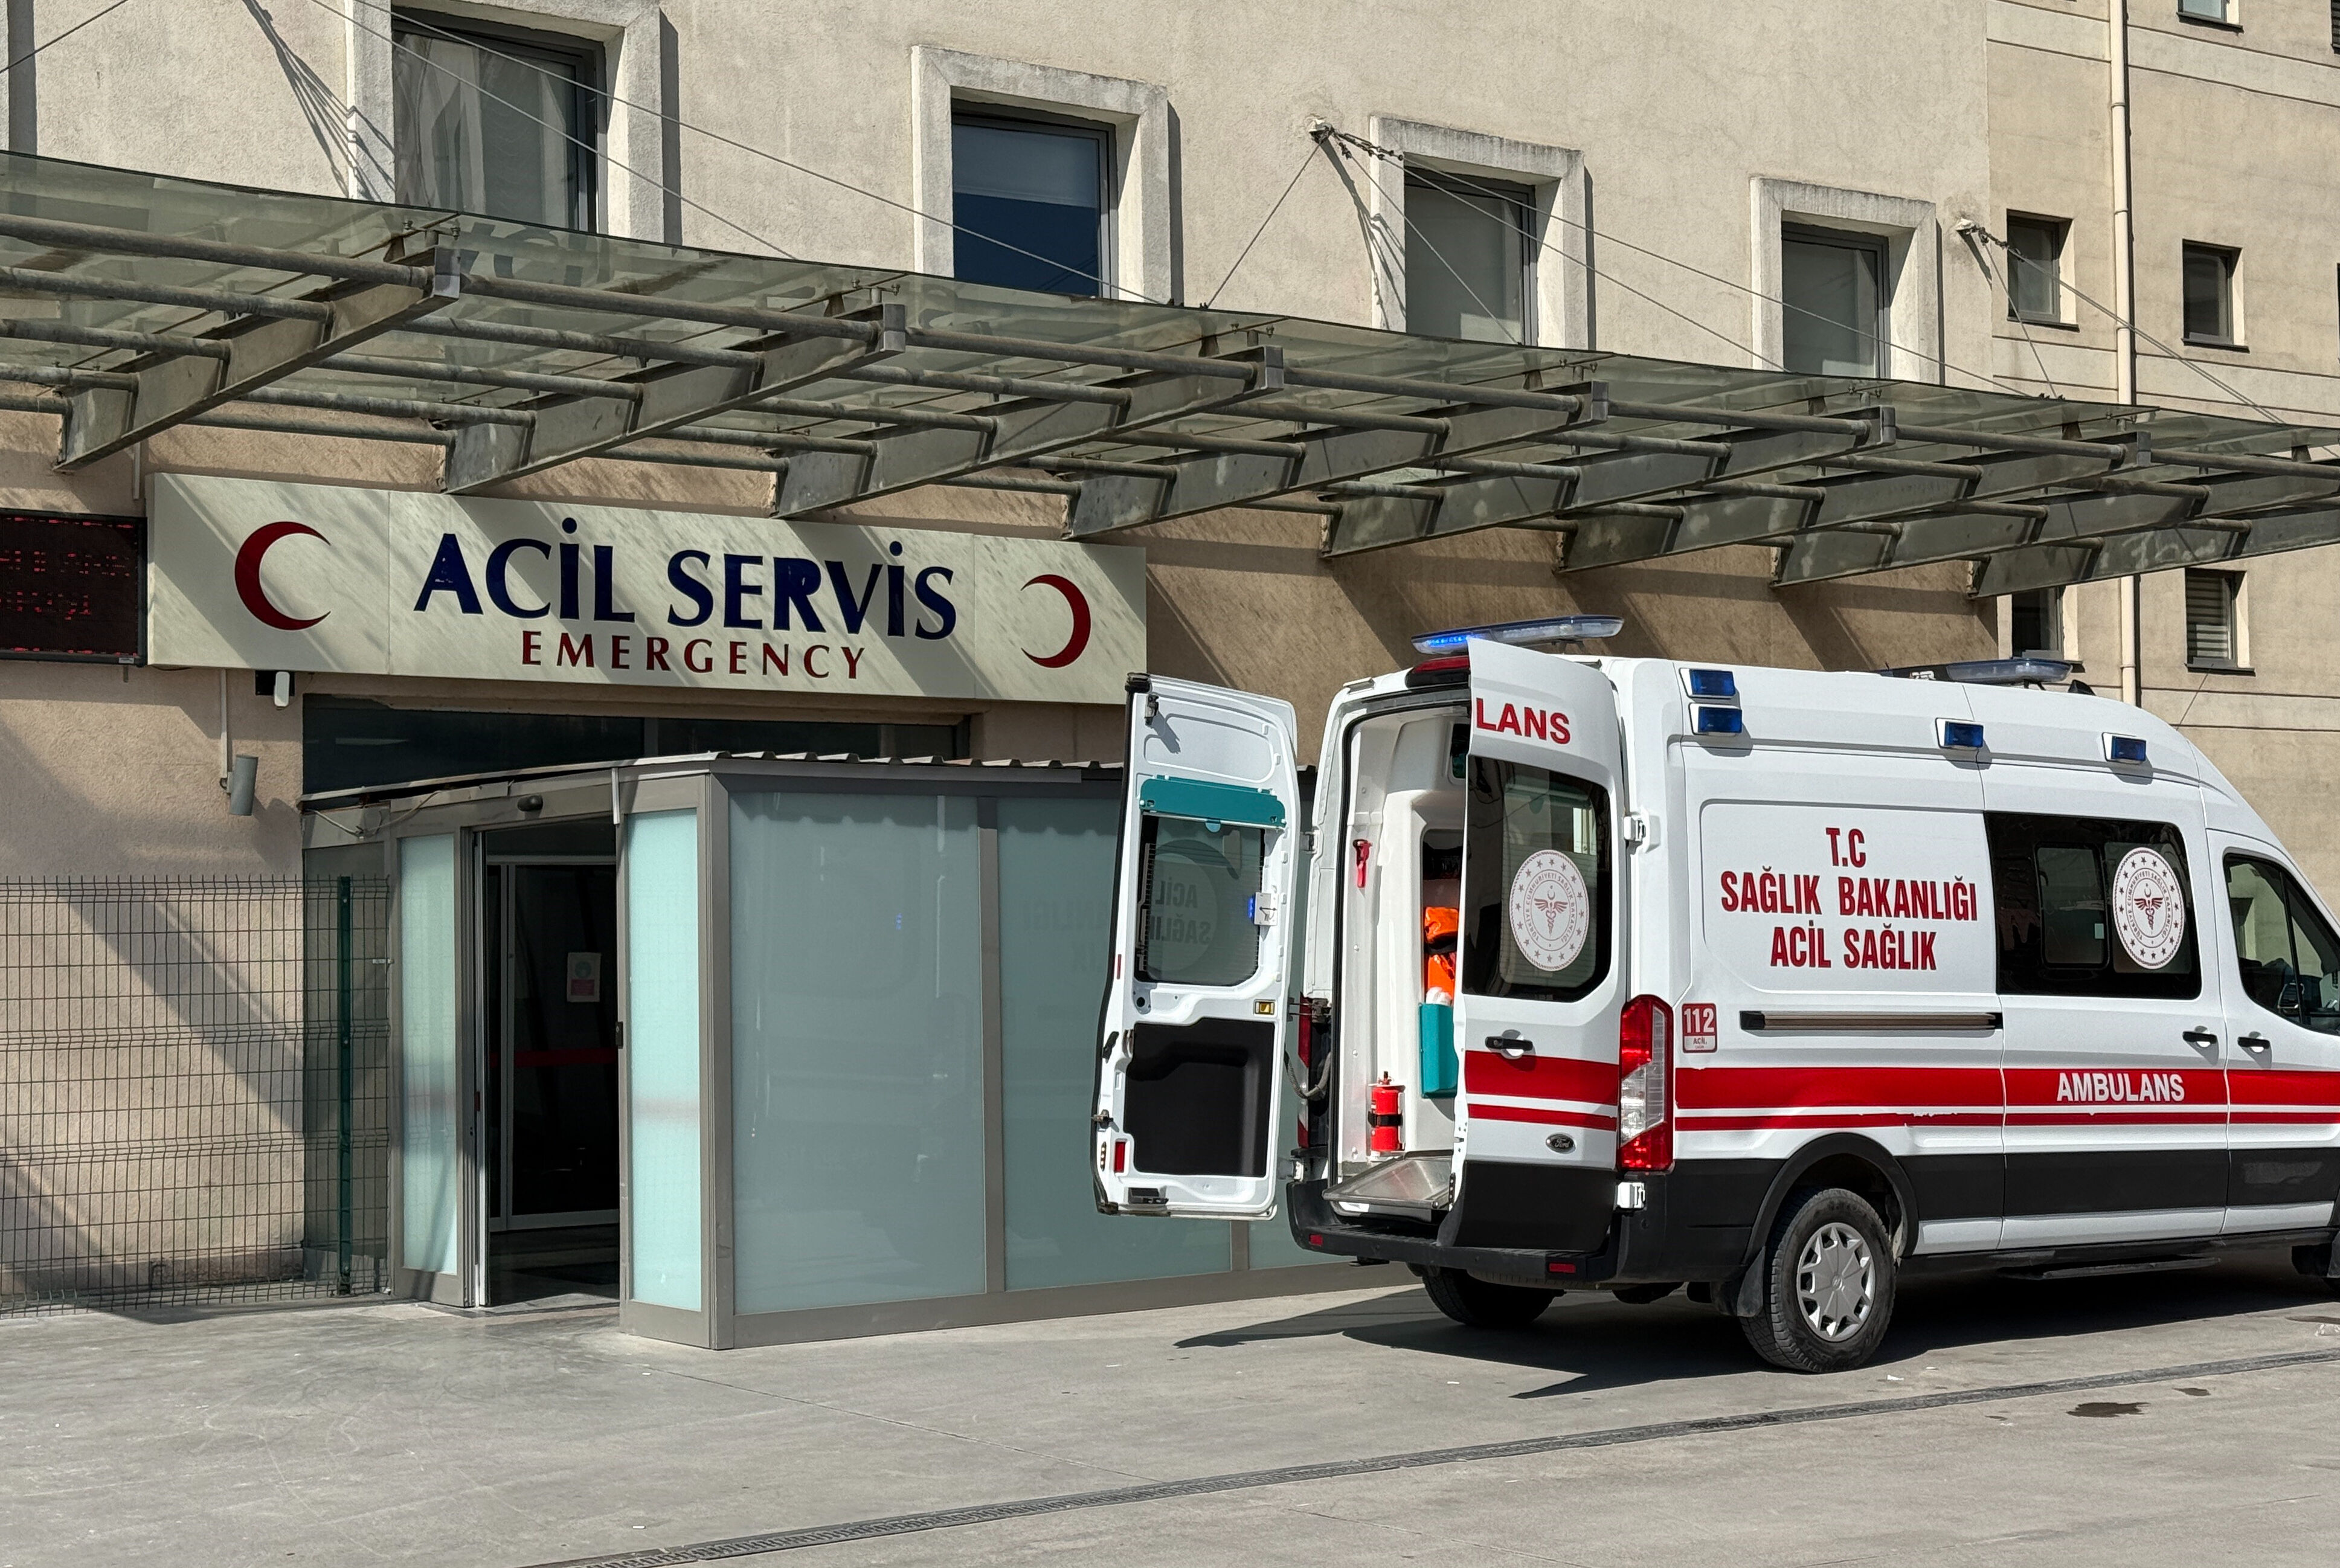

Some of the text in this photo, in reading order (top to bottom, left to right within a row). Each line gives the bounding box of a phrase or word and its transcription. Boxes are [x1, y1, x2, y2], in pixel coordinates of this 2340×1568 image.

[414, 518, 957, 641] ACİL SERVİS
[521, 631, 866, 680] EMERGENCY
[1475, 698, 1572, 745] LANS
[1825, 827, 1866, 868] T.C
[1720, 866, 1978, 922] SAĞLIK BAKANLIĞI
[1770, 920, 1937, 970] ACİL SAĞLIK
[1683, 1007, 1715, 1033] 112
[2056, 1072, 2185, 1102] AMBULANS
